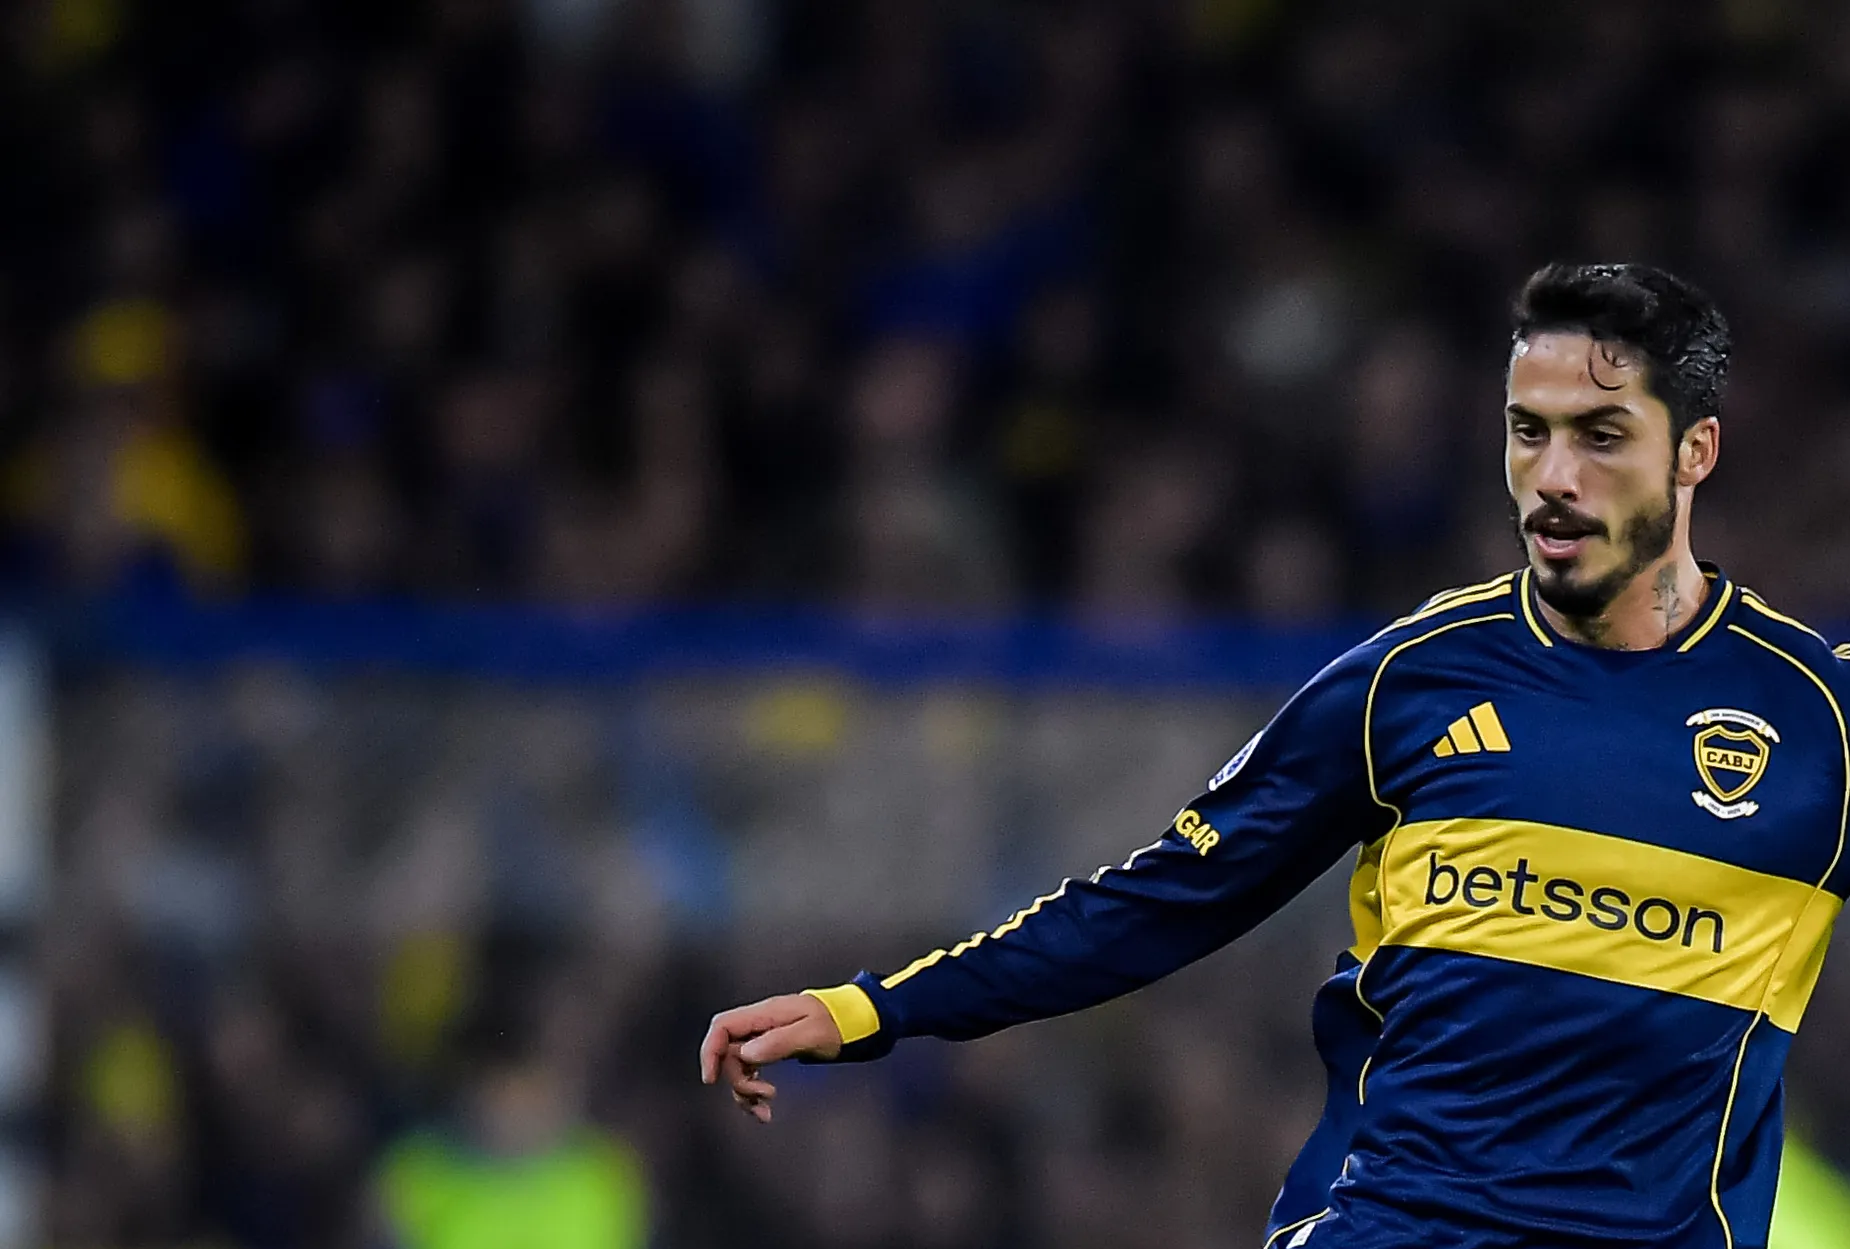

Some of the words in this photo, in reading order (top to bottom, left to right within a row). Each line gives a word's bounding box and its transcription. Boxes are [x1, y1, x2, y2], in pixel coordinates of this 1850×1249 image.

[1706, 751, 1755, 770] CABJ
[1173, 807, 1220, 857] GAR
[1424, 852, 1724, 954] betsson
